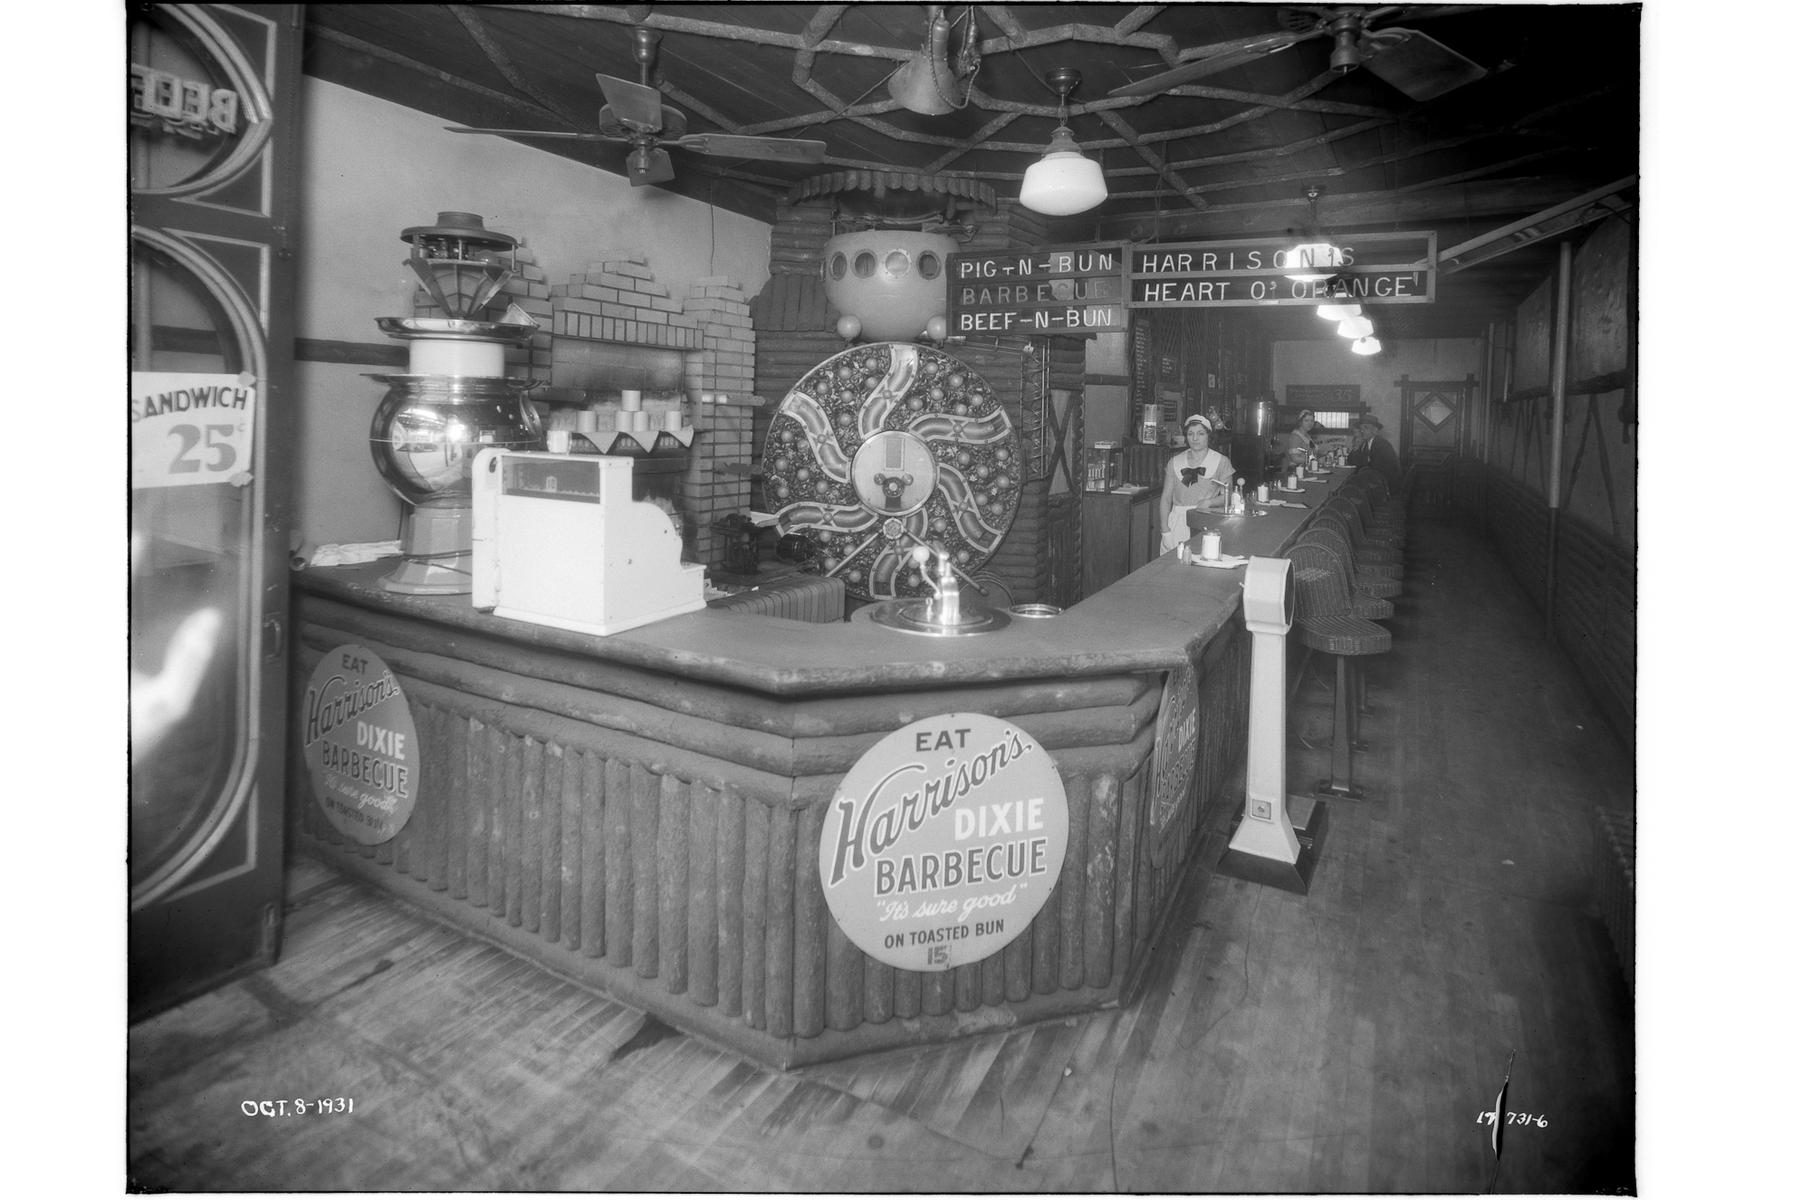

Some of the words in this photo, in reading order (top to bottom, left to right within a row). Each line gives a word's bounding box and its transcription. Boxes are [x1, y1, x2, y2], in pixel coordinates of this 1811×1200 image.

[962, 281, 1110, 305] BARBECUE
[1144, 281, 1230, 302] HEART
[961, 308, 1111, 331] BEEF-N-BUN
[342, 653, 368, 675] EAT
[304, 670, 400, 747] Harrison's
[357, 721, 405, 761] DIXIE
[915, 728, 971, 752] EAT
[321, 739, 408, 799] BARBECUE
[830, 730, 1033, 886] Harrison's
[954, 798, 1044, 841] DIXIE
[874, 837, 1047, 897] BARBECUE
[912, 899, 958, 919] sure
[884, 933, 905, 950] ON
[909, 924, 969, 946] TOASTED
[975, 919, 1005, 938] BUN
